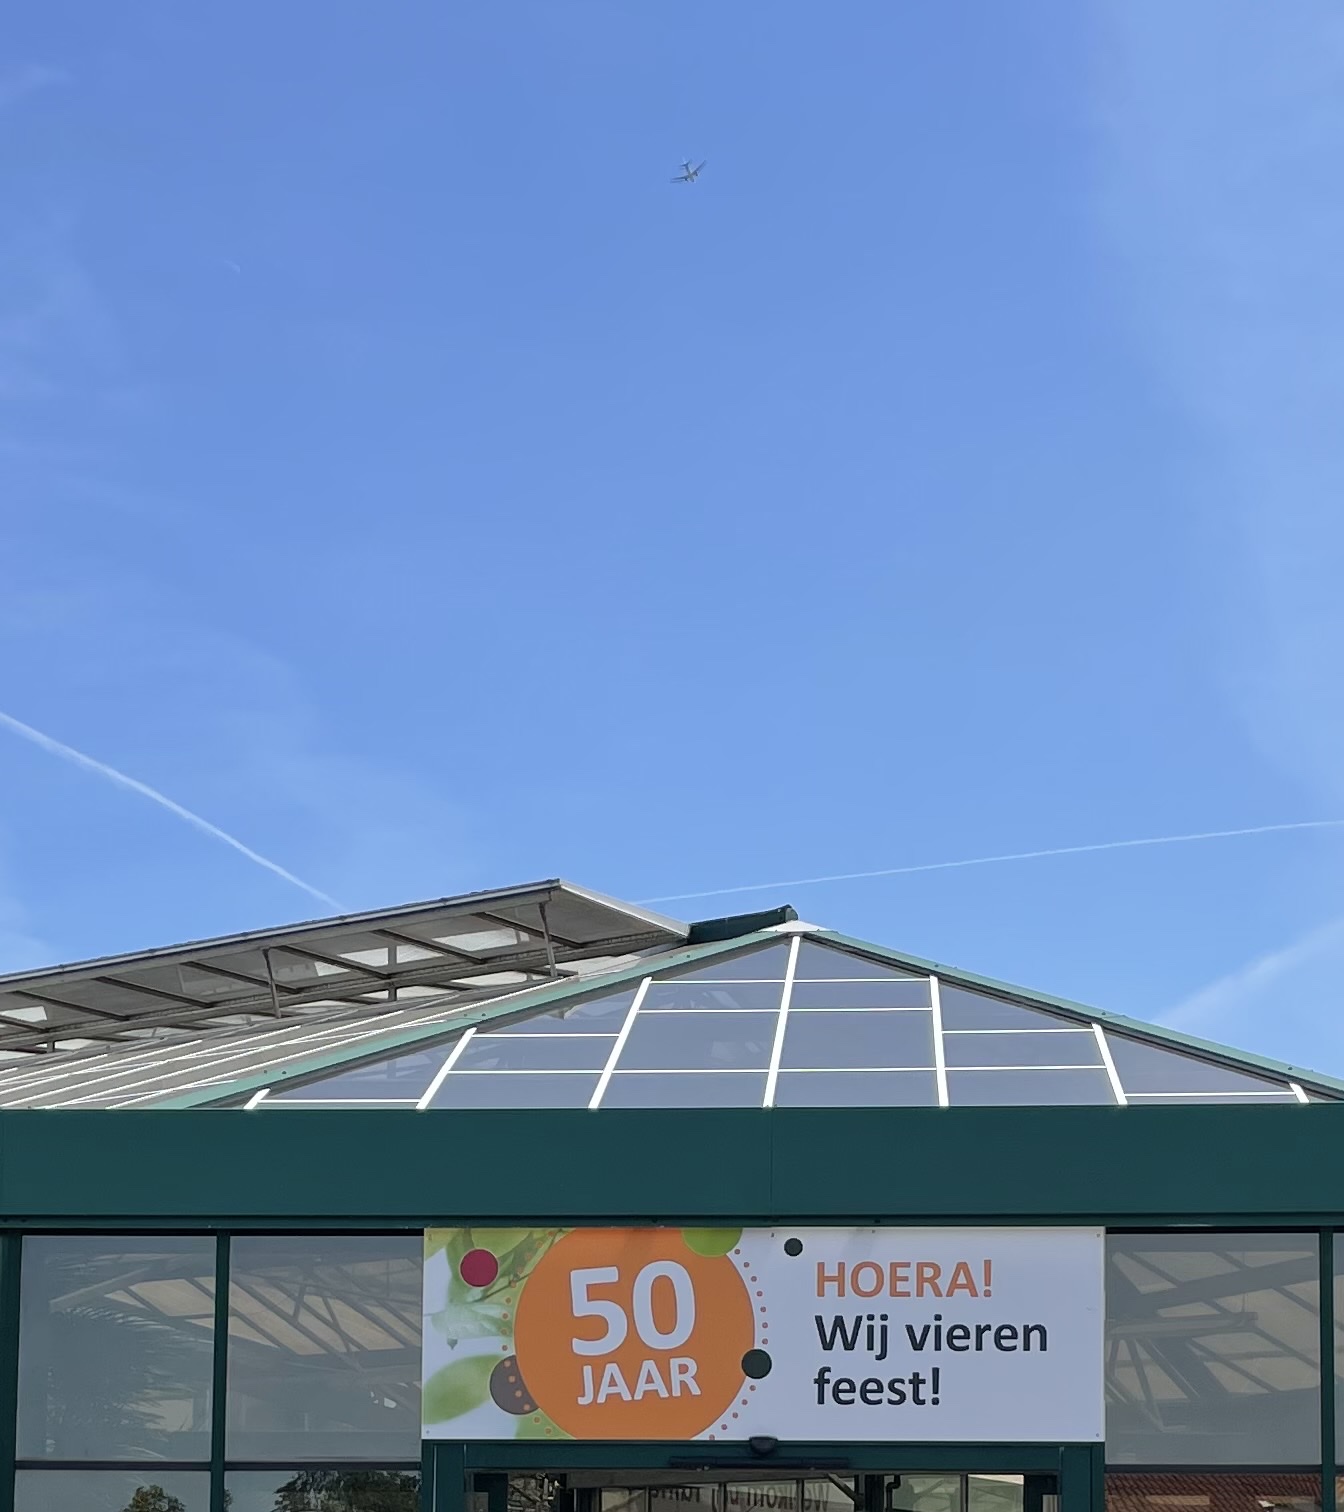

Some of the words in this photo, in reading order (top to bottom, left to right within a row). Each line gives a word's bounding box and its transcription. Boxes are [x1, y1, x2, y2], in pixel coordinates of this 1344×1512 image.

[815, 1259, 993, 1298] HOERA!
[569, 1259, 697, 1357] 50
[814, 1314, 889, 1359] Wij
[906, 1314, 1049, 1352] vieren
[577, 1356, 701, 1406] JAAR
[813, 1367, 942, 1406] feest!
